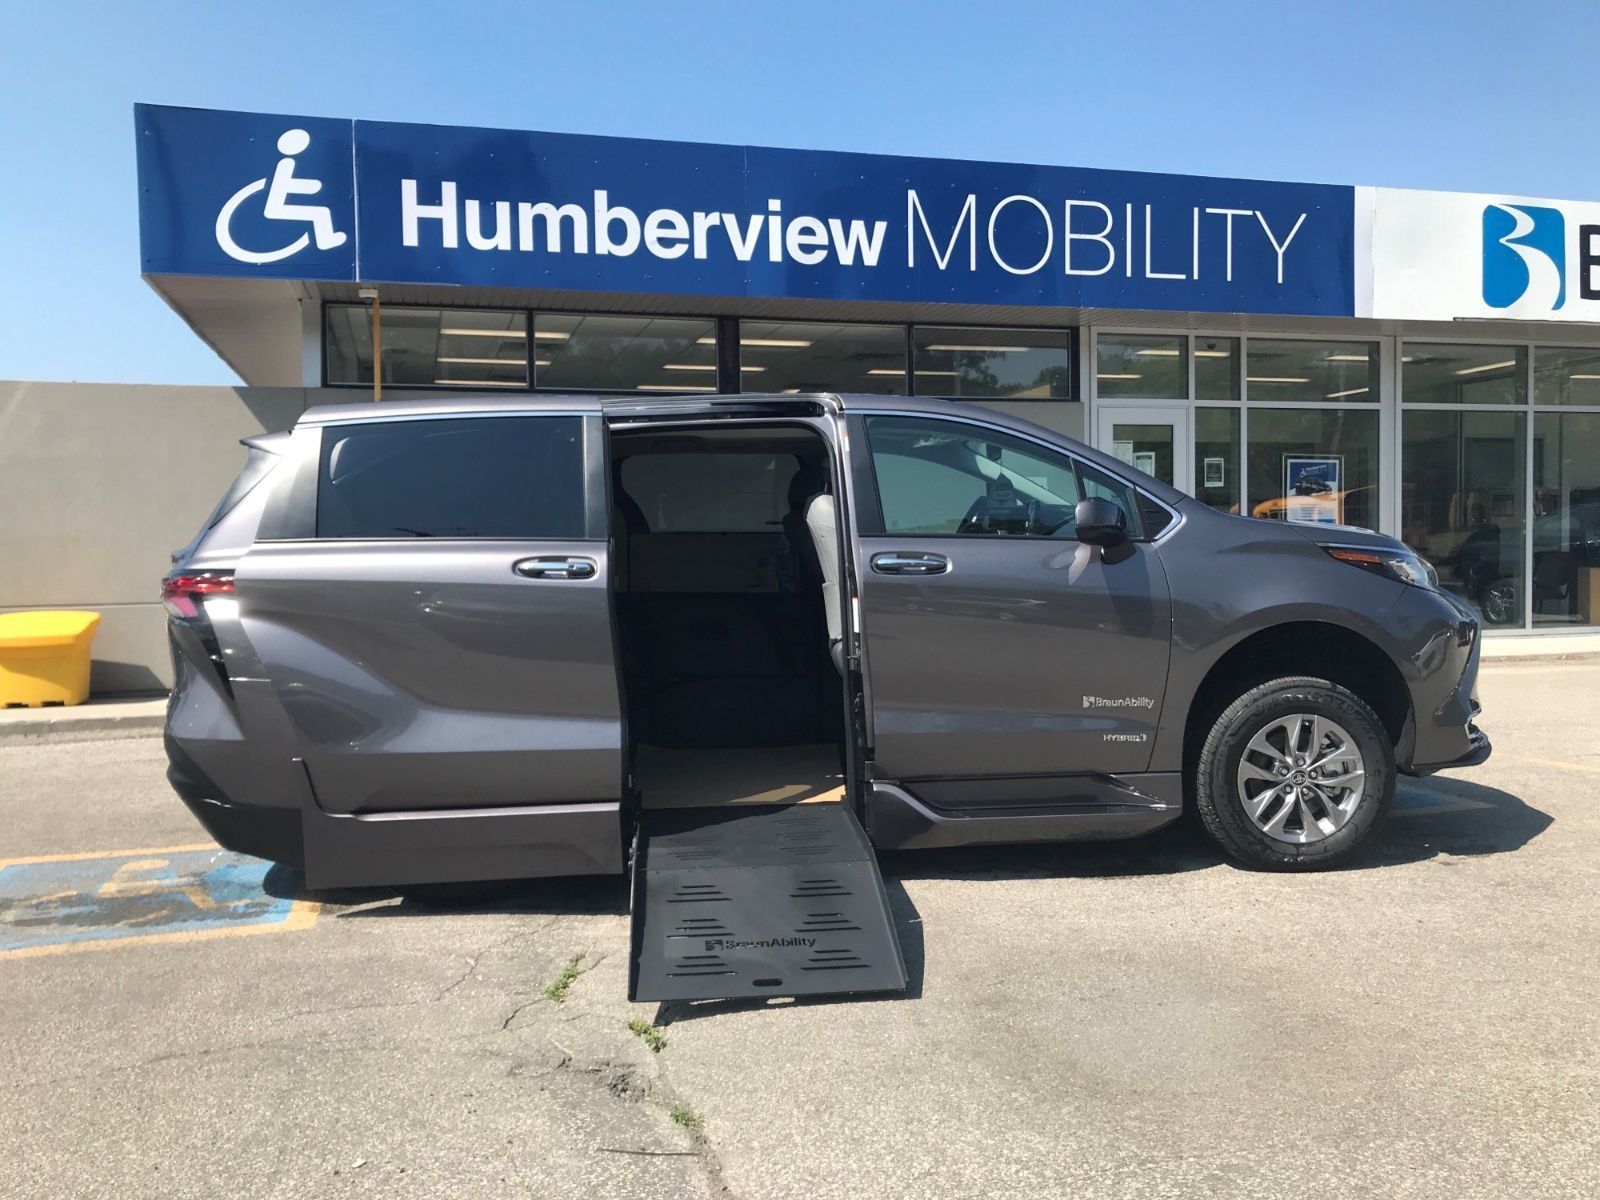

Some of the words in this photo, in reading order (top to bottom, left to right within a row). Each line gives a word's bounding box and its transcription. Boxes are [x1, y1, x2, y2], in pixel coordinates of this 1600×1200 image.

[401, 178, 888, 268] Humberview
[907, 189, 1307, 284] MOBILITY
[1095, 696, 1155, 709] BraunAbility
[724, 936, 816, 950] BraunAbility
